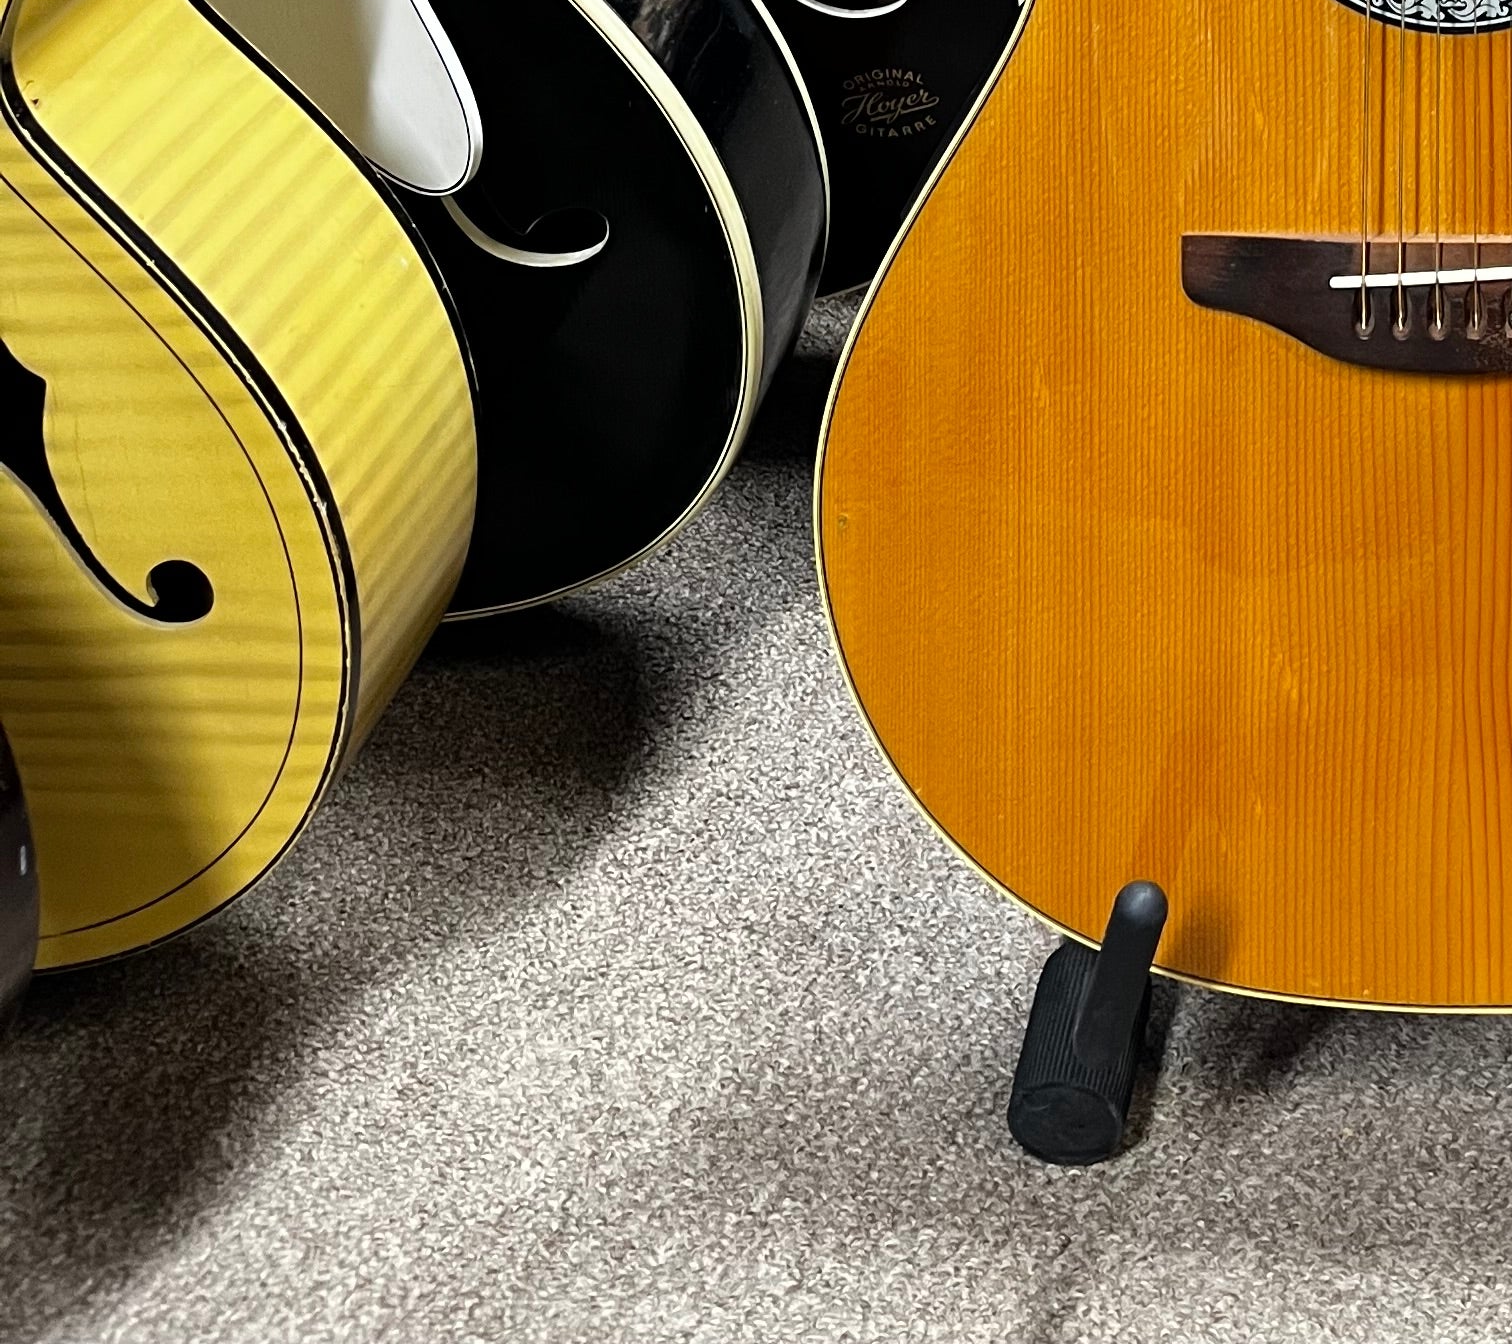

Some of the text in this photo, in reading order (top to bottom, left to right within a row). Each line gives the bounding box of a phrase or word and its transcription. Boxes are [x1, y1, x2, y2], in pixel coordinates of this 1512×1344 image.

[843, 68, 925, 91] ORIGINAL
[841, 89, 940, 125] Hoyer
[856, 114, 937, 138] GITARRE
